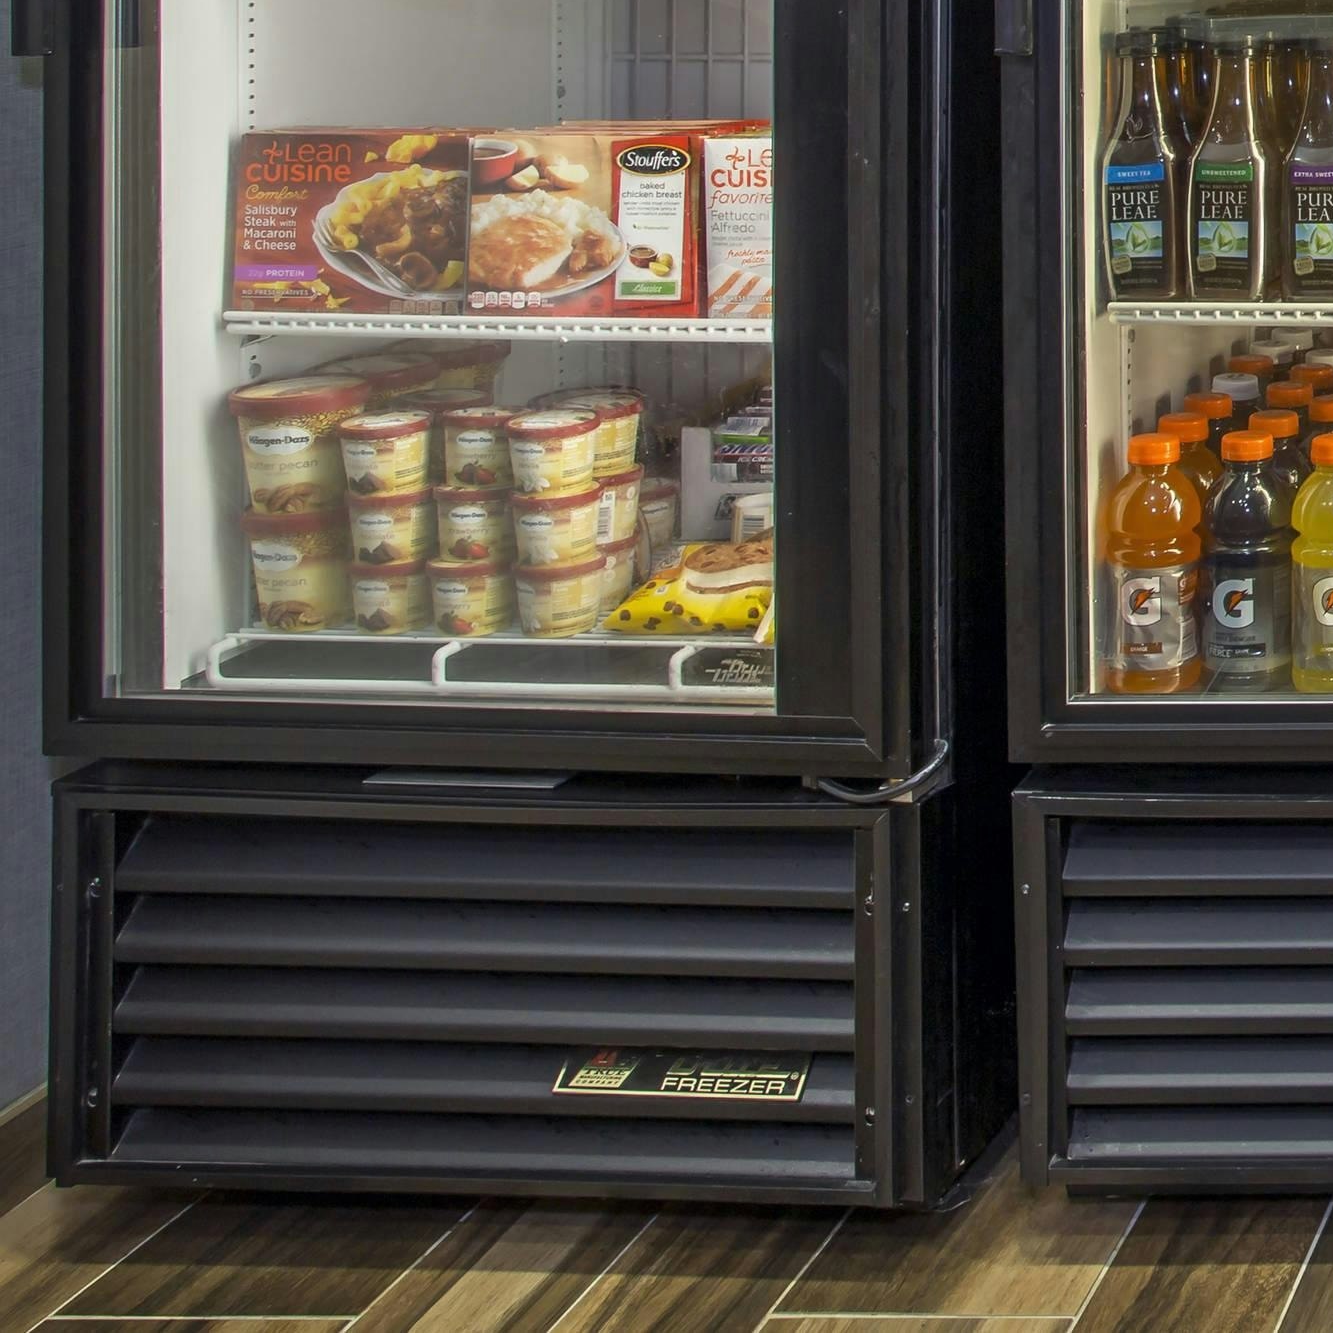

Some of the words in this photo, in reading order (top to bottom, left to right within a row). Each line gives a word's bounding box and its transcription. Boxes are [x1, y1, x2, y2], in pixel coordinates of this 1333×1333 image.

[625, 149, 681, 170] Stouffer's
[245, 184, 308, 200] Comfort
[622, 190, 654, 198] chicken
[655, 189, 682, 198] breast
[1111, 191, 1160, 207] PURE
[1201, 192, 1247, 206] PURE
[244, 204, 298, 218] Salisbury
[1111, 206, 1157, 219] LEAF
[1201, 206, 1244, 219] LEAF
[244, 217, 276, 227] Steak
[710, 222, 756, 234] Alfredo
[244, 228, 296, 239] Macaroni
[243, 240, 251, 250] &
[254, 240, 296, 250] Cheese
[266, 269, 304, 277] PROTEIN
[660, 1077, 787, 1095] FREEZER
